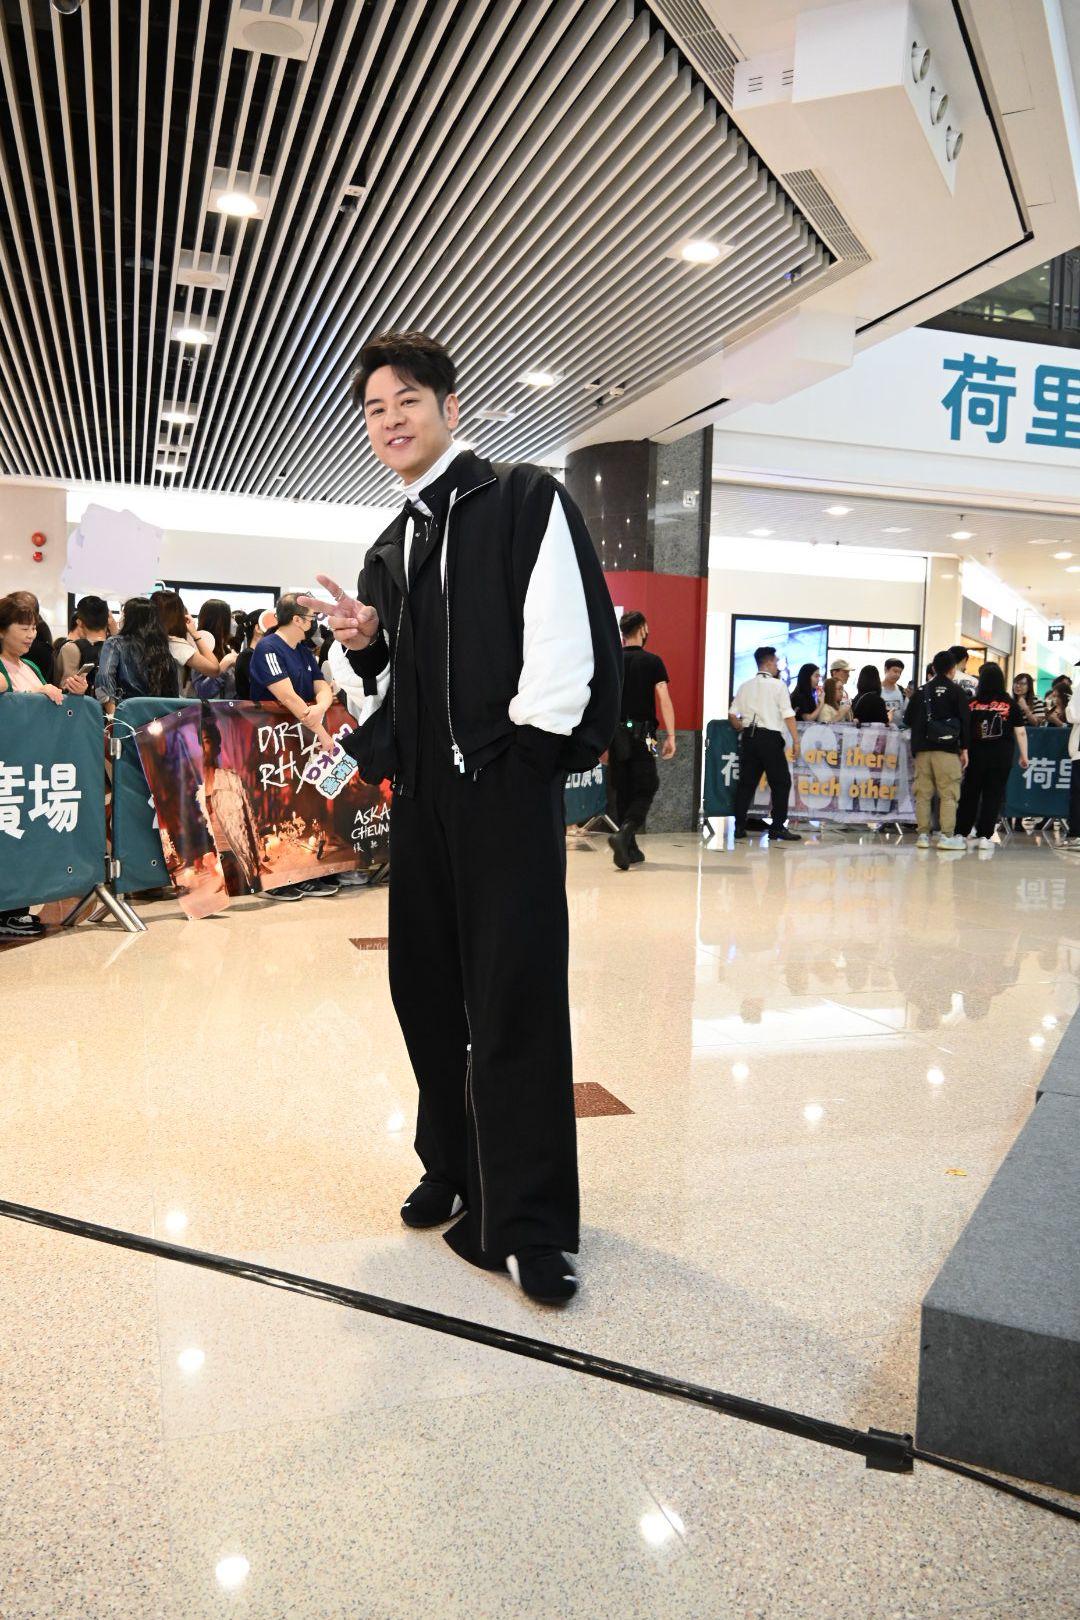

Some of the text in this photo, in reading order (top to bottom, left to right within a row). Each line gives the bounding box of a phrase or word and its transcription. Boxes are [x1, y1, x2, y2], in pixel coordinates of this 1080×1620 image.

[941, 352, 1080, 449] 荷里
[804, 749, 838, 766] are
[846, 745, 897, 769] there
[848, 778, 897, 800] other
[353, 802, 390, 825] ASKA
[351, 823, 390, 840] CHEUN
